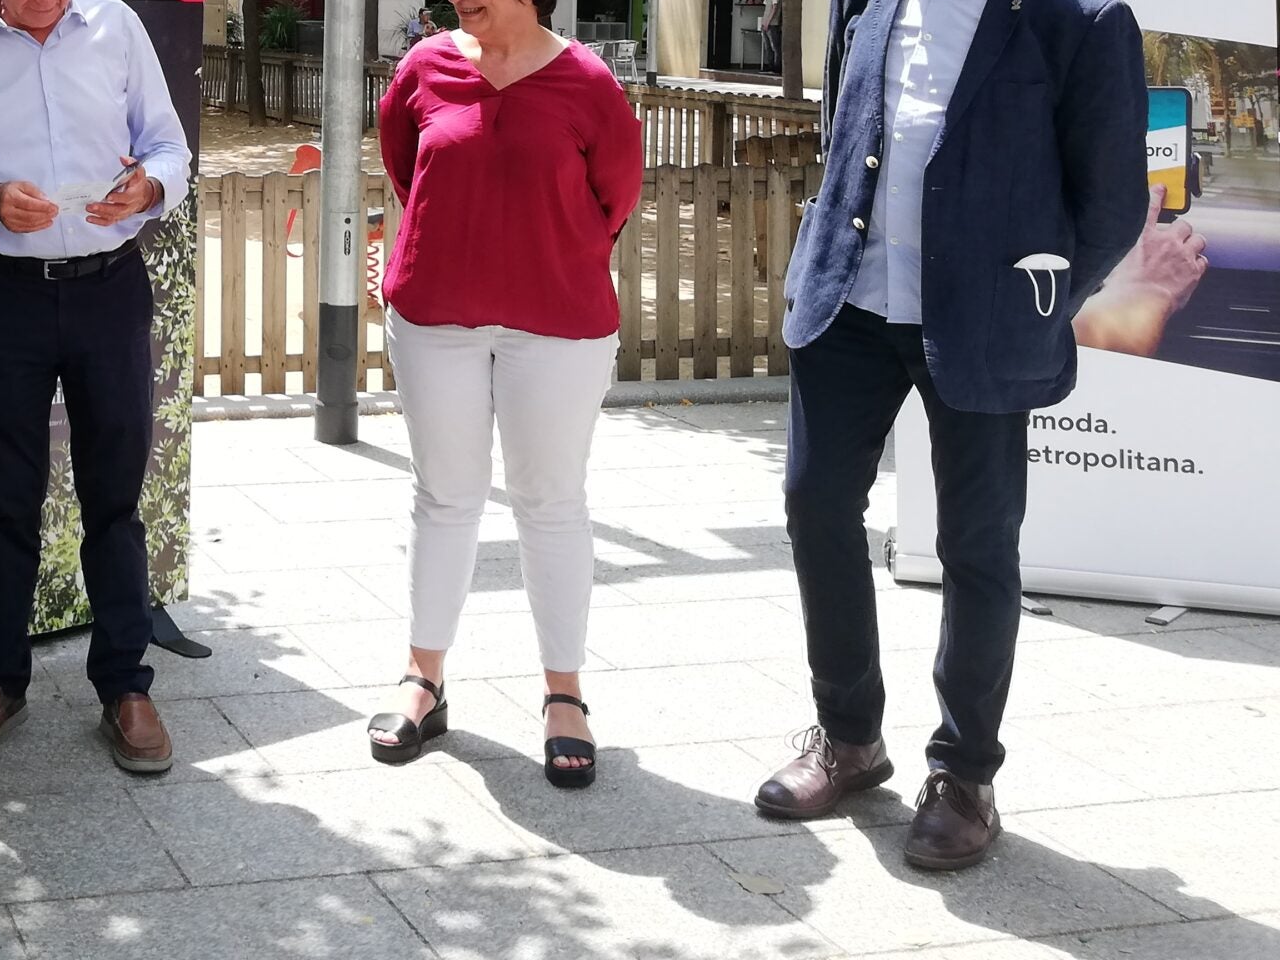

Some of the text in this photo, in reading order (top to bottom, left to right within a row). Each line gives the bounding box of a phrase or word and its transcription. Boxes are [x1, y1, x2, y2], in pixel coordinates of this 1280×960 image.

[1146, 143, 1178, 161] pro]
[1026, 413, 1118, 434] moda.
[1027, 445, 1204, 475] etropolitana.
